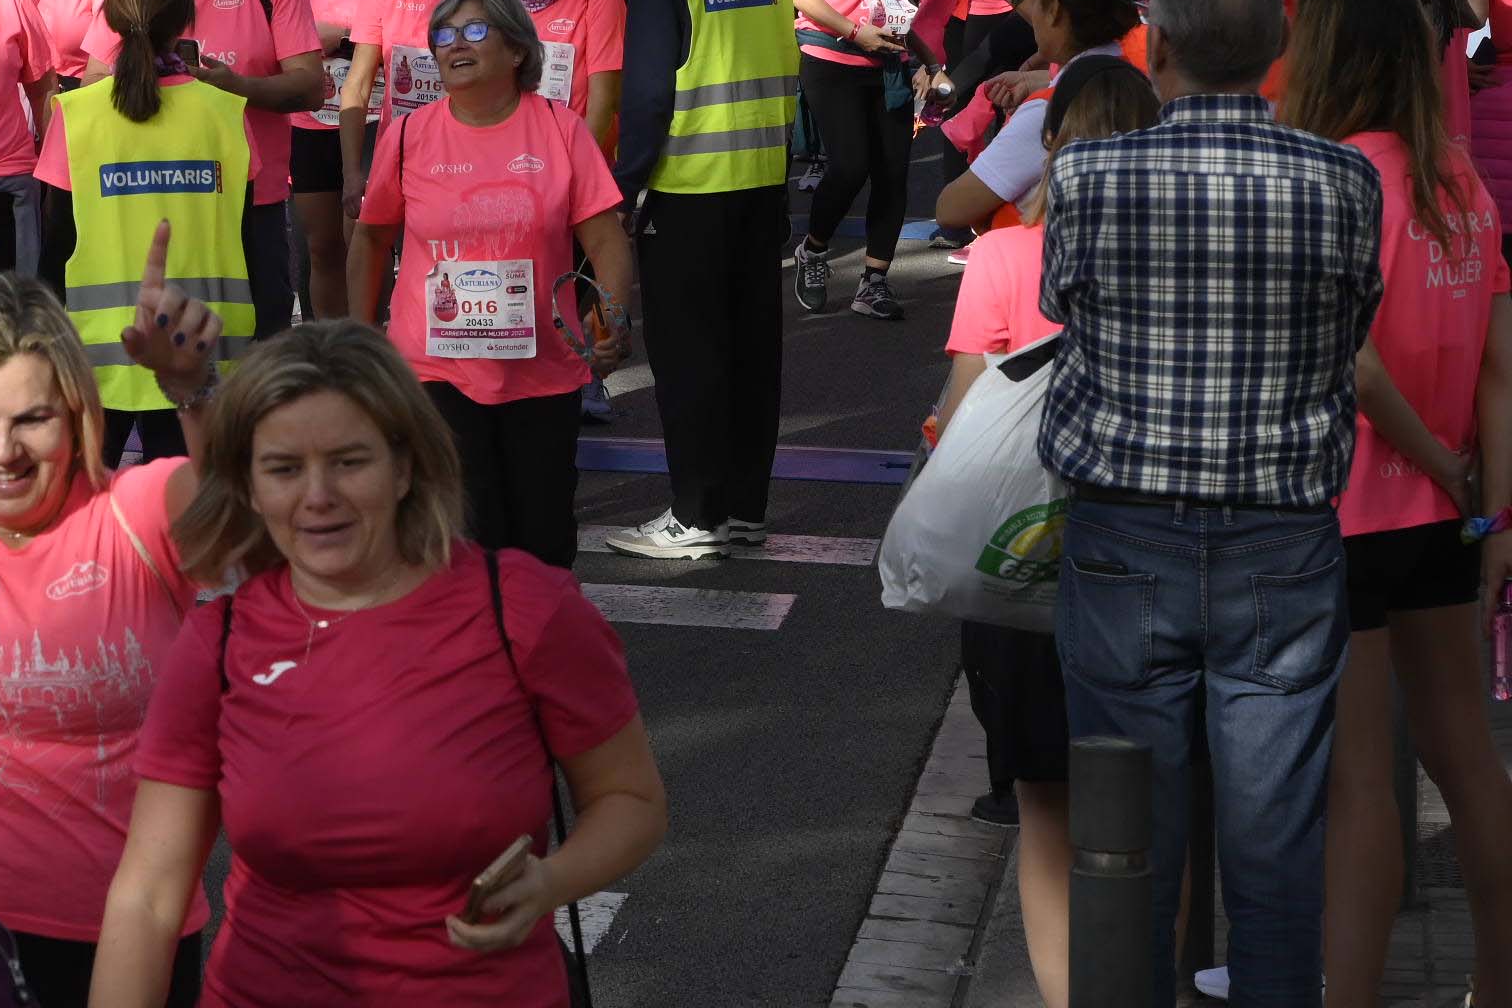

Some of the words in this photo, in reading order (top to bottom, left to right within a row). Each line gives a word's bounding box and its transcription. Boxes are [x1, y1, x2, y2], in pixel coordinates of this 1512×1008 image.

[888, 15, 907, 25] 016
[414, 79, 444, 92] 016
[430, 162, 473, 175] OYSHO
[102, 169, 213, 189] VOLUNTARIS
[426, 239, 459, 262] TU
[505, 271, 526, 280] SUMA
[458, 277, 500, 287] ASTURIANA
[461, 300, 498, 315] 016
[465, 317, 494, 328] 20433
[440, 329, 469, 338] CARRERA
[469, 329, 478, 338] DE
[478, 329, 488, 338] LA
[487, 329, 509, 338] MUJER
[509, 329, 526, 337] 2023
[437, 342, 470, 352] OYSHO
[494, 342, 529, 352] Santander
